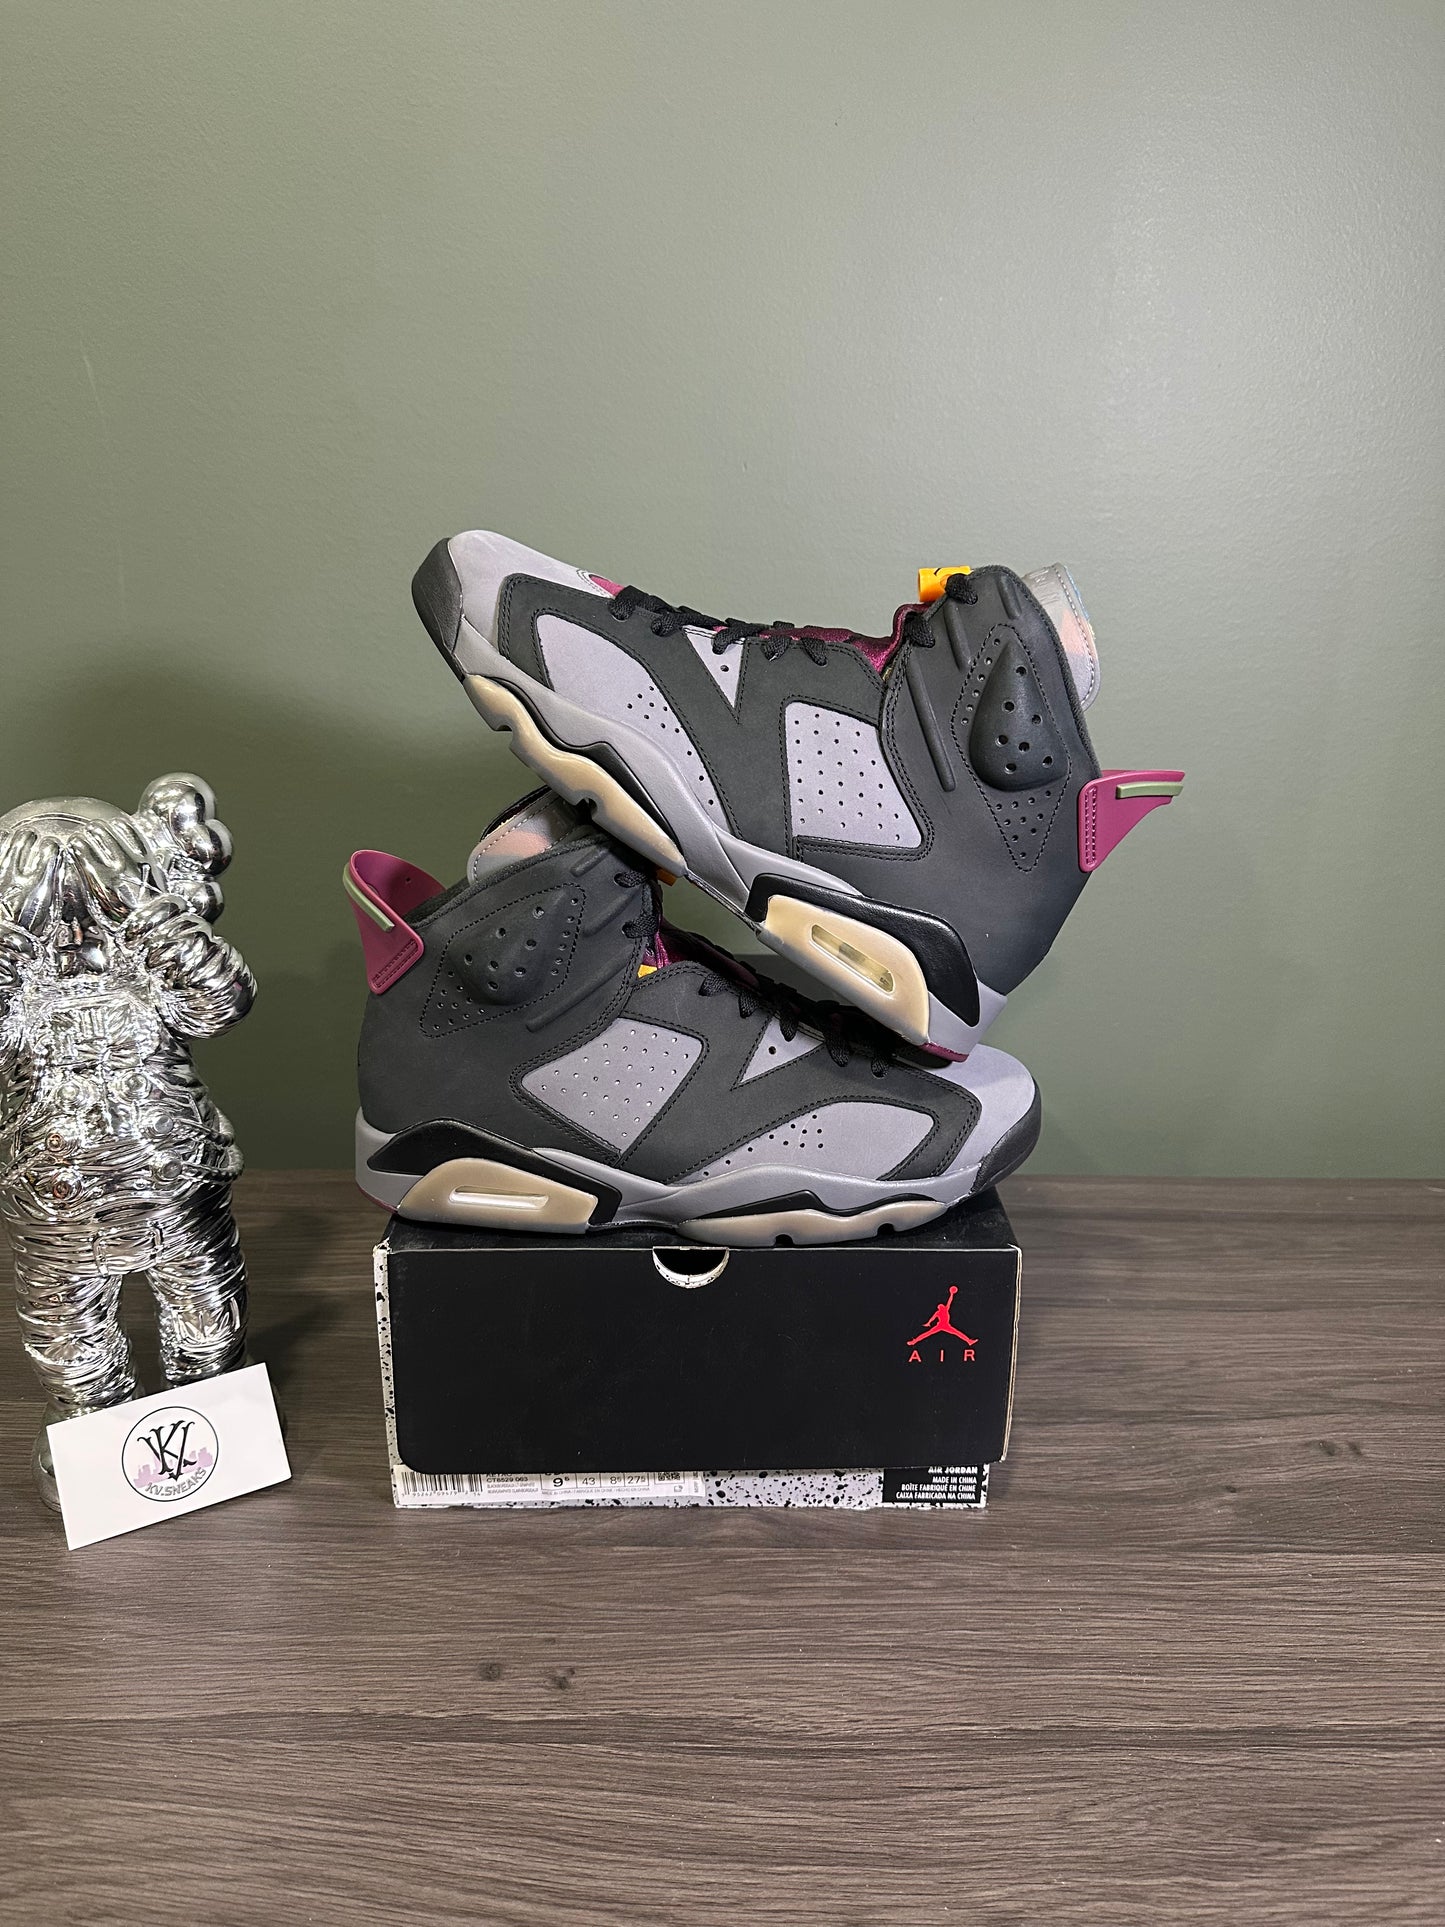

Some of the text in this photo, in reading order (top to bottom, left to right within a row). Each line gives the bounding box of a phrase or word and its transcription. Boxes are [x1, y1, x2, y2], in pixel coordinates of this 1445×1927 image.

[908, 1349, 975, 1362] AIR
[945, 1466, 978, 1474] JORDAN
[582, 1477, 596, 1485] 43
[959, 1476, 977, 1484] CHINA
[919, 1483, 948, 1491] FABRIQUÉ
[958, 1484, 976, 1492] CHINE
[896, 1491, 914, 1499] CAIXA
[947, 1491, 957, 1499] NA
[957, 1492, 976, 1500] CHINA
